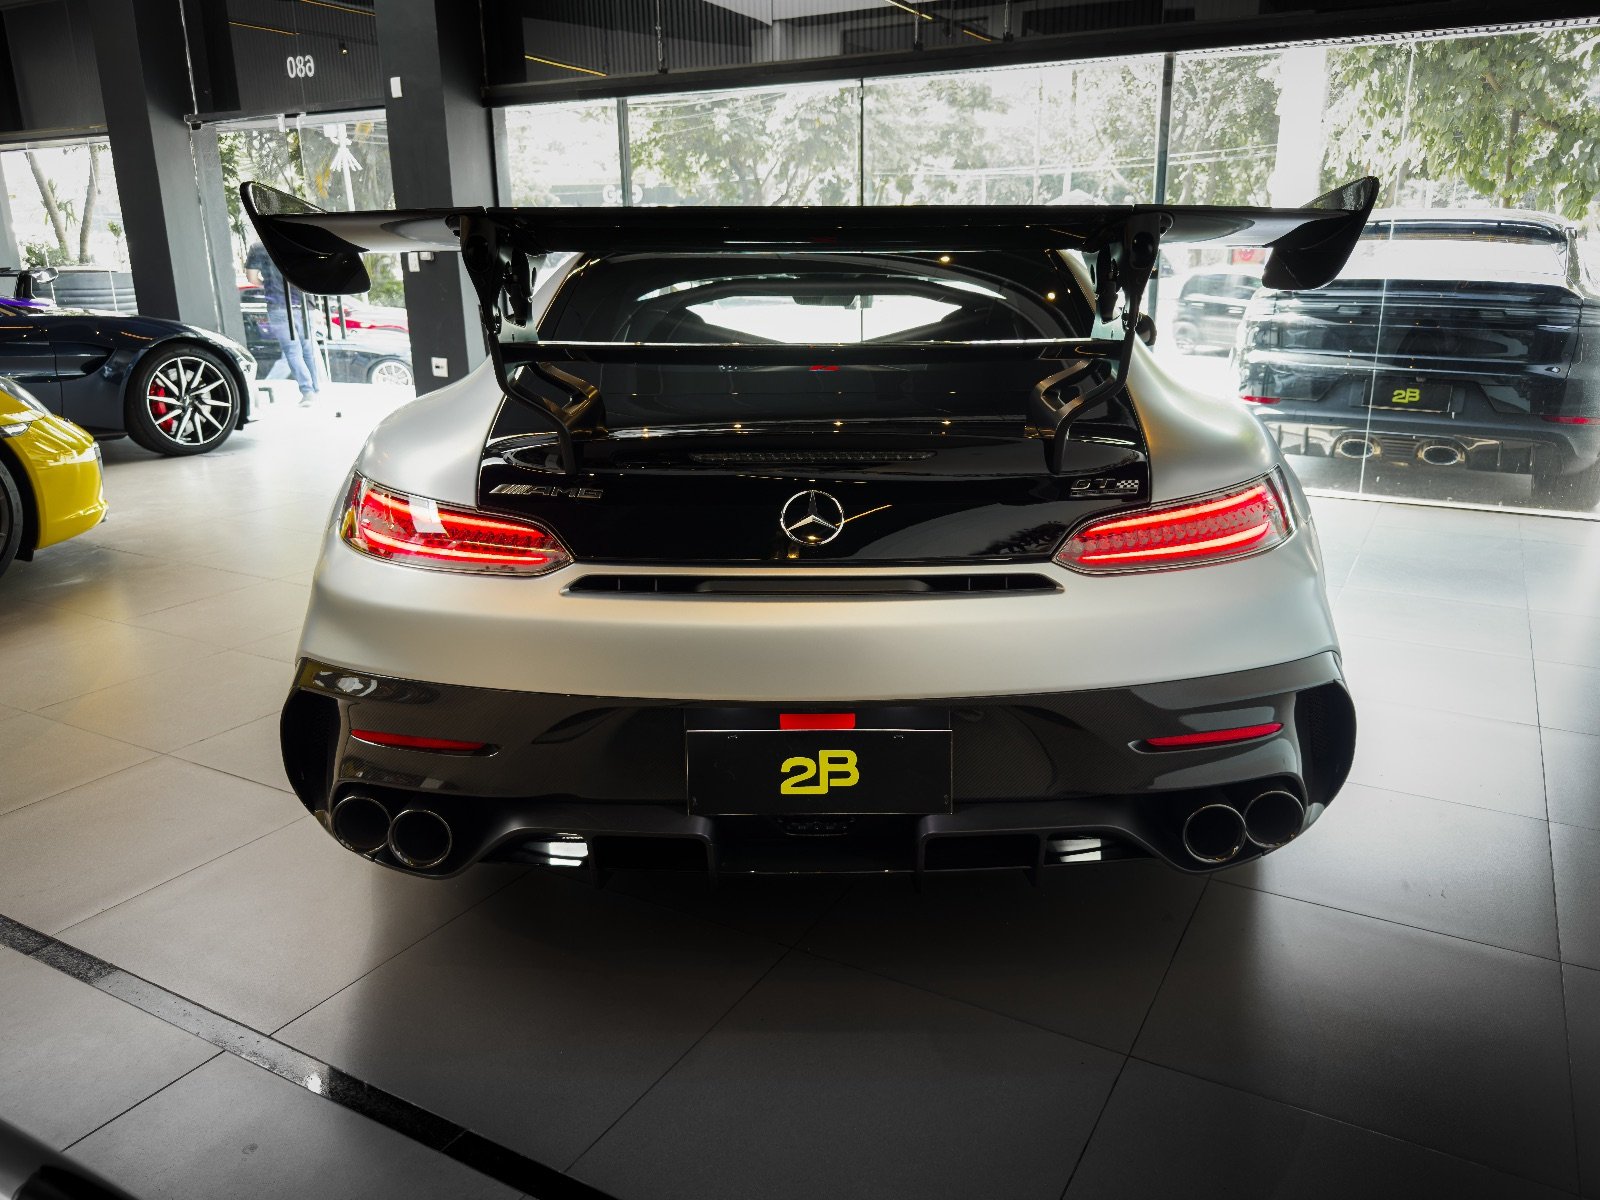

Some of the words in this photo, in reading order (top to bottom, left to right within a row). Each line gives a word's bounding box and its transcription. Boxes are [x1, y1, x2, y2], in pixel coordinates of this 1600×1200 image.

[1391, 387, 1420, 404] 2B
[519, 484, 605, 499] AMG
[780, 749, 860, 795] 2B
